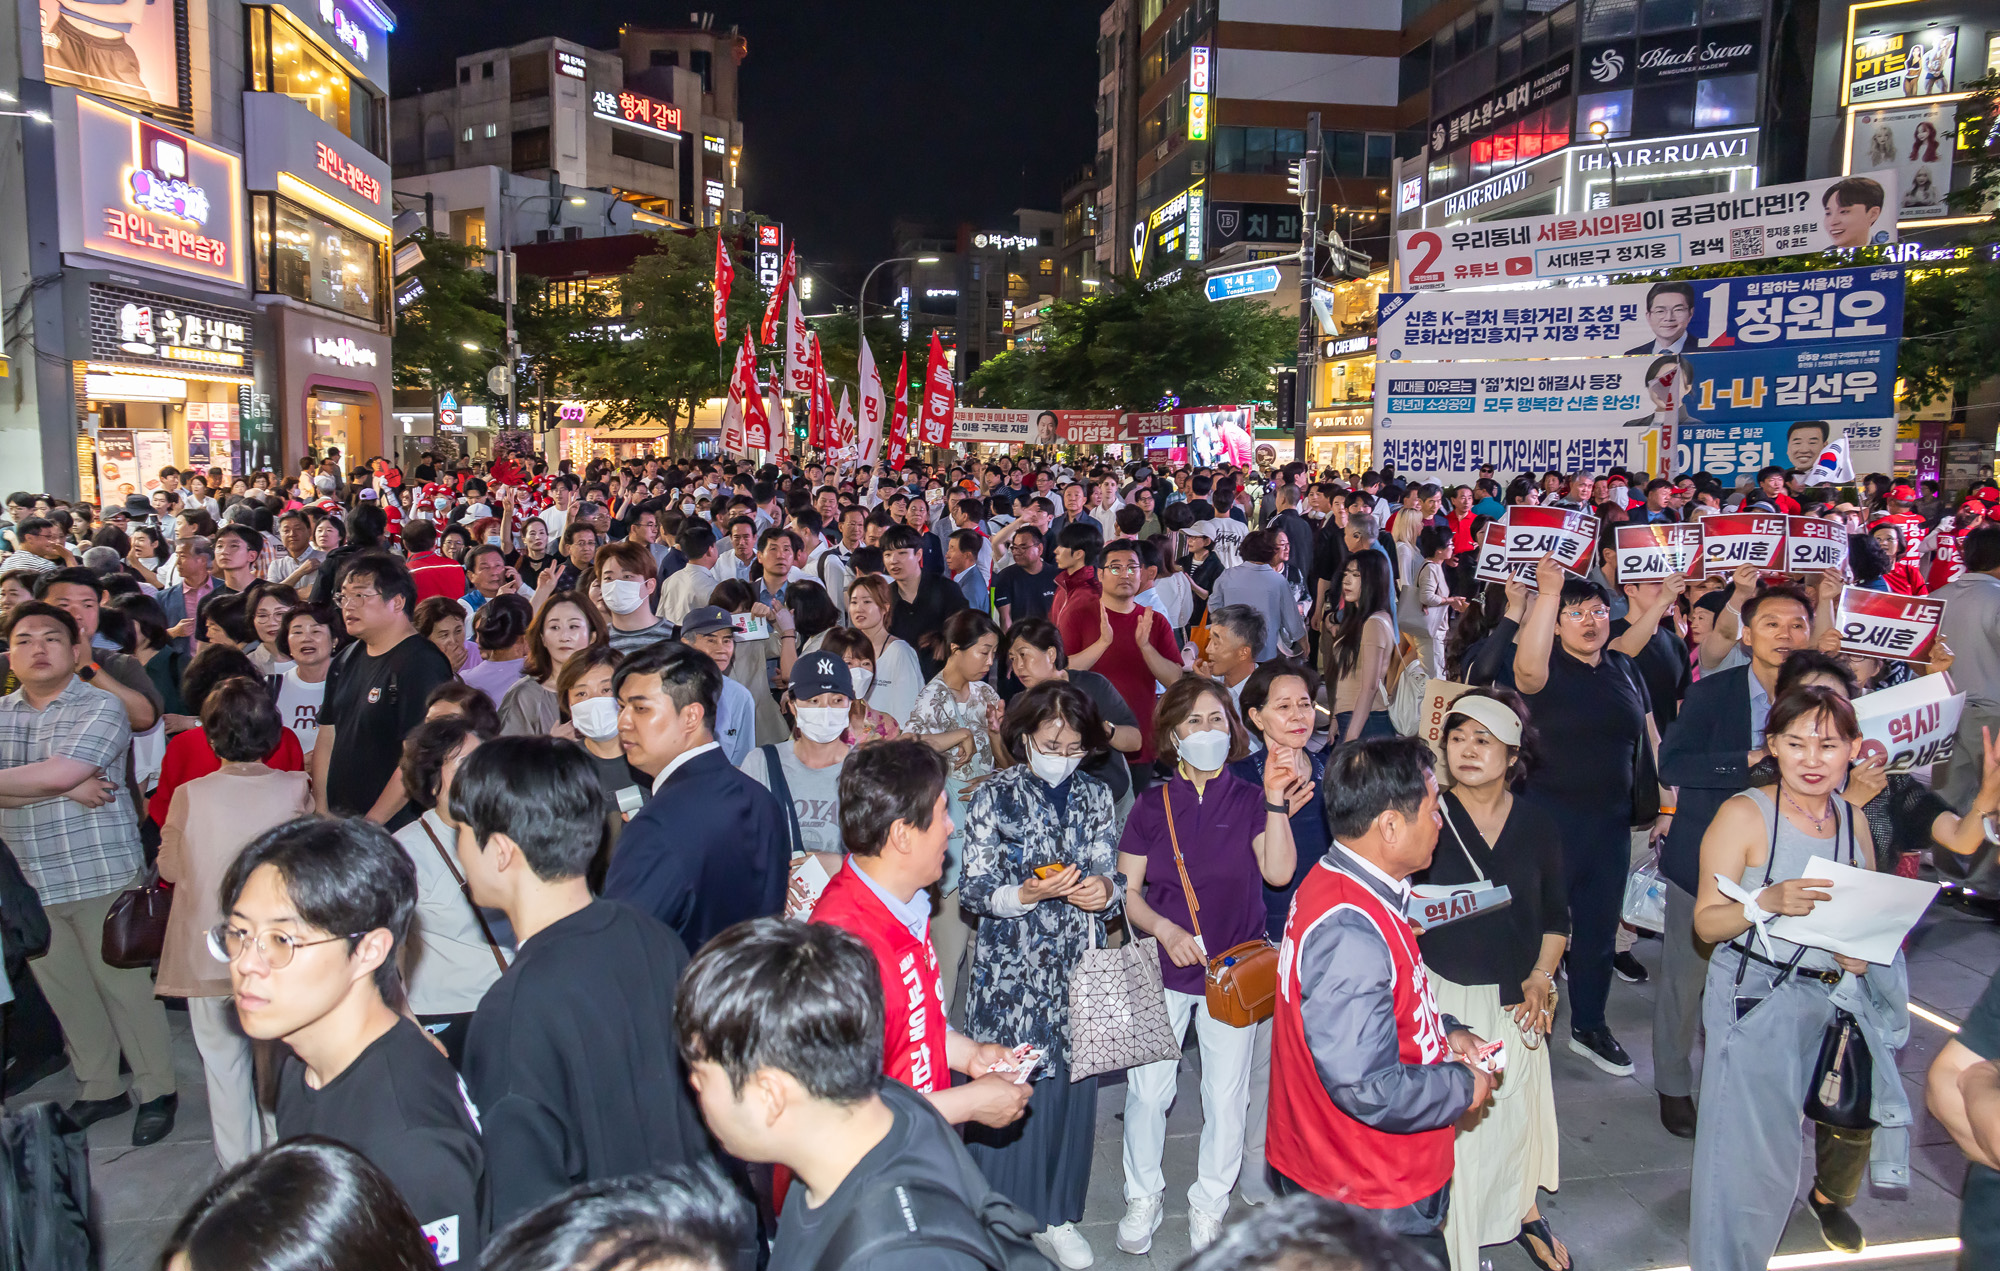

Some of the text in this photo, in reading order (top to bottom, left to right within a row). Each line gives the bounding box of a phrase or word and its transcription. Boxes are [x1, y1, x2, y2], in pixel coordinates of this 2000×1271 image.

[1636, 42, 1753, 69] Black Swan
[1533, 63, 1570, 88] ANNOUNCER
[1658, 62, 1729, 76] ANNOUNCER ACADEMY
[1856, 53, 1906, 80] PT는
[1533, 80, 1562, 101] ACADEMY
[1852, 75, 1901, 97] 빌드업짐
[593, 91, 682, 131] 신촌 형제 갈비
[1449, 82, 1530, 142] 블랙스완스피치
[1578, 138, 1748, 172] [HAIR:RUAV]
[316, 141, 381, 205] 코인노래연습장
[1188, 189, 1203, 197] 365
[1444, 170, 1527, 217] [HAIR:RUAV]
[1452, 225, 1530, 251] 우리동네
[1537, 210, 1664, 242] 서울시의원이
[1672, 191, 1810, 228] 궁금하다면!?
[1766, 222, 1818, 239] 정지웅 유튜브
[106, 207, 227, 267] 코인노래연습장
[763, 228, 775, 238] 24
[989, 234, 1037, 250] 벽제갈비
[1776, 237, 1808, 250] QR 코드
[1454, 237, 1724, 280] 유튜브 서대문구 정지웅 검색
[1955, 247, 1974, 259] 3F
[1224, 274, 1255, 290] 연세로
[1747, 275, 1853, 296] 일 잘하는 서울시장
[1870, 270, 1898, 281] 민주당
[1380, 295, 1405, 318] 서대문
[1405, 304, 1638, 327] 신촌 K-컬처 특화거리 조성 및
[1698, 282, 1886, 348] 1 정원오
[1404, 323, 1620, 345] 문화산업진흥지구 지정 추진
[1392, 380, 1425, 393] 세대를
[1427, 379, 1473, 393] 아우르는
[1538, 375, 1586, 391] 해결사
[1589, 374, 1622, 391] 등장
[1697, 371, 1878, 411] 1-나 김선우
[1392, 394, 1640, 413] 청년과 소상공인 모두 행복한 신촌 완성!
[962, 423, 979, 432] 이용
[981, 423, 1008, 433] 구독료
[1010, 424, 1028, 434] 지원
[1067, 427, 1115, 442] 이성헌
[1138, 416, 1173, 433] 조전혁
[1683, 427, 1764, 440] 일 잘하는 큰 일꾼
[1843, 425, 1882, 438] 민주당
[1383, 438, 1467, 472] 청년창업지원
[1489, 439, 1563, 473] 디자인센터
[1566, 437, 1628, 472] 설립추진
[1677, 441, 1774, 476] 이동화
[1752, 519, 1784, 536] 너도
[1803, 522, 1828, 538] 우리
[1509, 533, 1579, 560] 오세훈
[1705, 541, 1769, 562] 오세훈
[1947, 564, 1966, 582] 2
[1900, 603, 1941, 623] 나도
[1843, 621, 1918, 651] 오세훈
[1888, 701, 1941, 744] 역시!
[1424, 894, 1478, 923] 역시!
